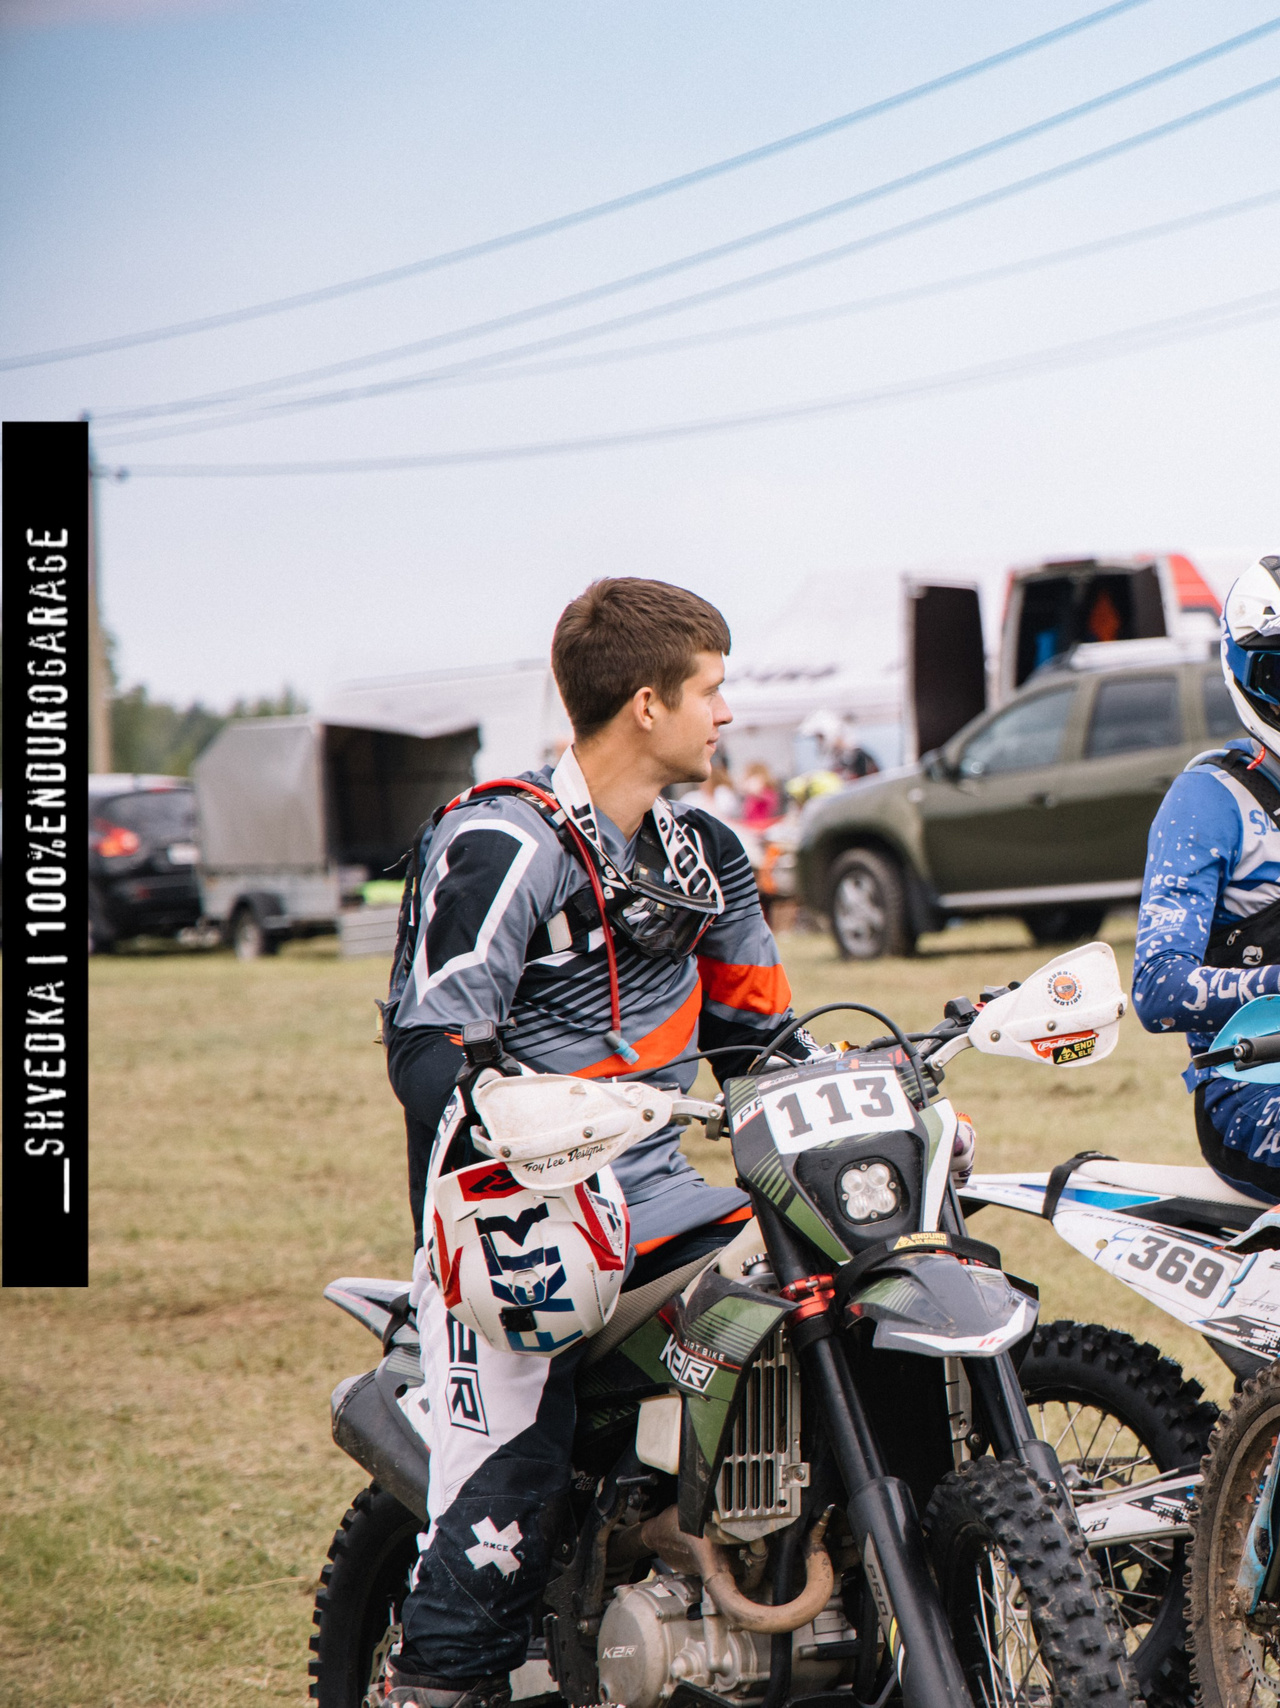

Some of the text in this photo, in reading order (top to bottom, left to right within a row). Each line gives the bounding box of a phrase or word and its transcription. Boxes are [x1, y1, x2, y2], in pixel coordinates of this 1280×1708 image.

[776, 1076, 895, 1139] 113
[522, 1143, 606, 1174] Troy Lee Designs
[1127, 1235, 1225, 1299] 369
[659, 1333, 718, 1392] K2R
[683, 1338, 701, 1352] DIRT
[701, 1346, 726, 1362] BIKE
[866, 1563, 889, 1617] PRO
[602, 1644, 638, 1659] K2R
